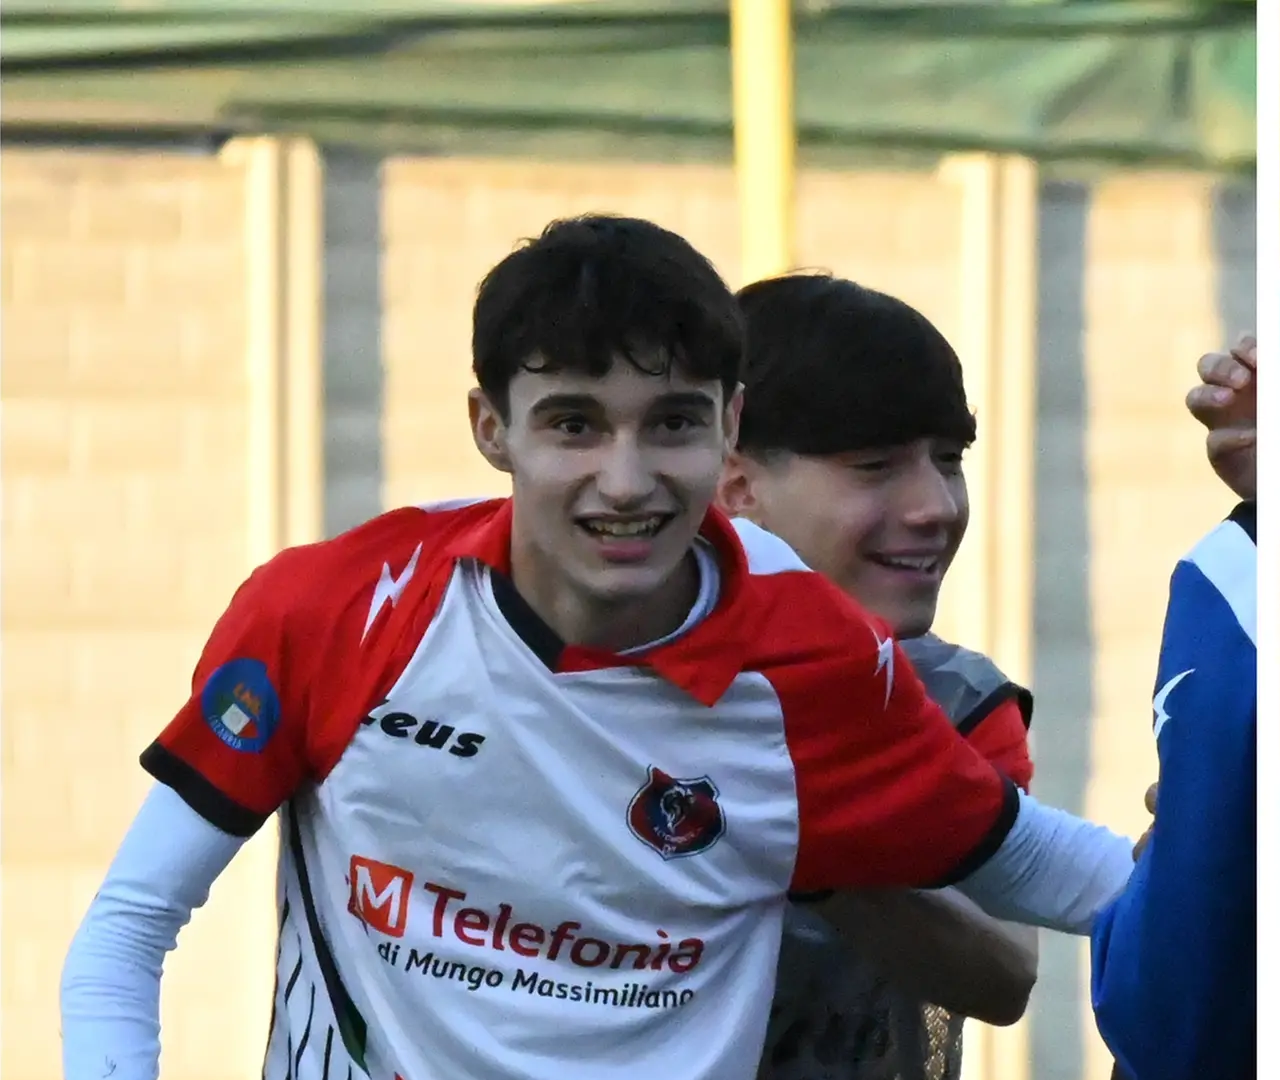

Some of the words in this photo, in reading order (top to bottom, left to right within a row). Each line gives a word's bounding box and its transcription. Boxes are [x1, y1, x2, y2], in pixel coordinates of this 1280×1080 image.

[354, 865, 404, 929] M
[423, 882, 705, 974] Telefonia
[377, 942, 399, 966] di
[405, 949, 504, 991] Mungo
[511, 968, 694, 1010] Massimiliano
